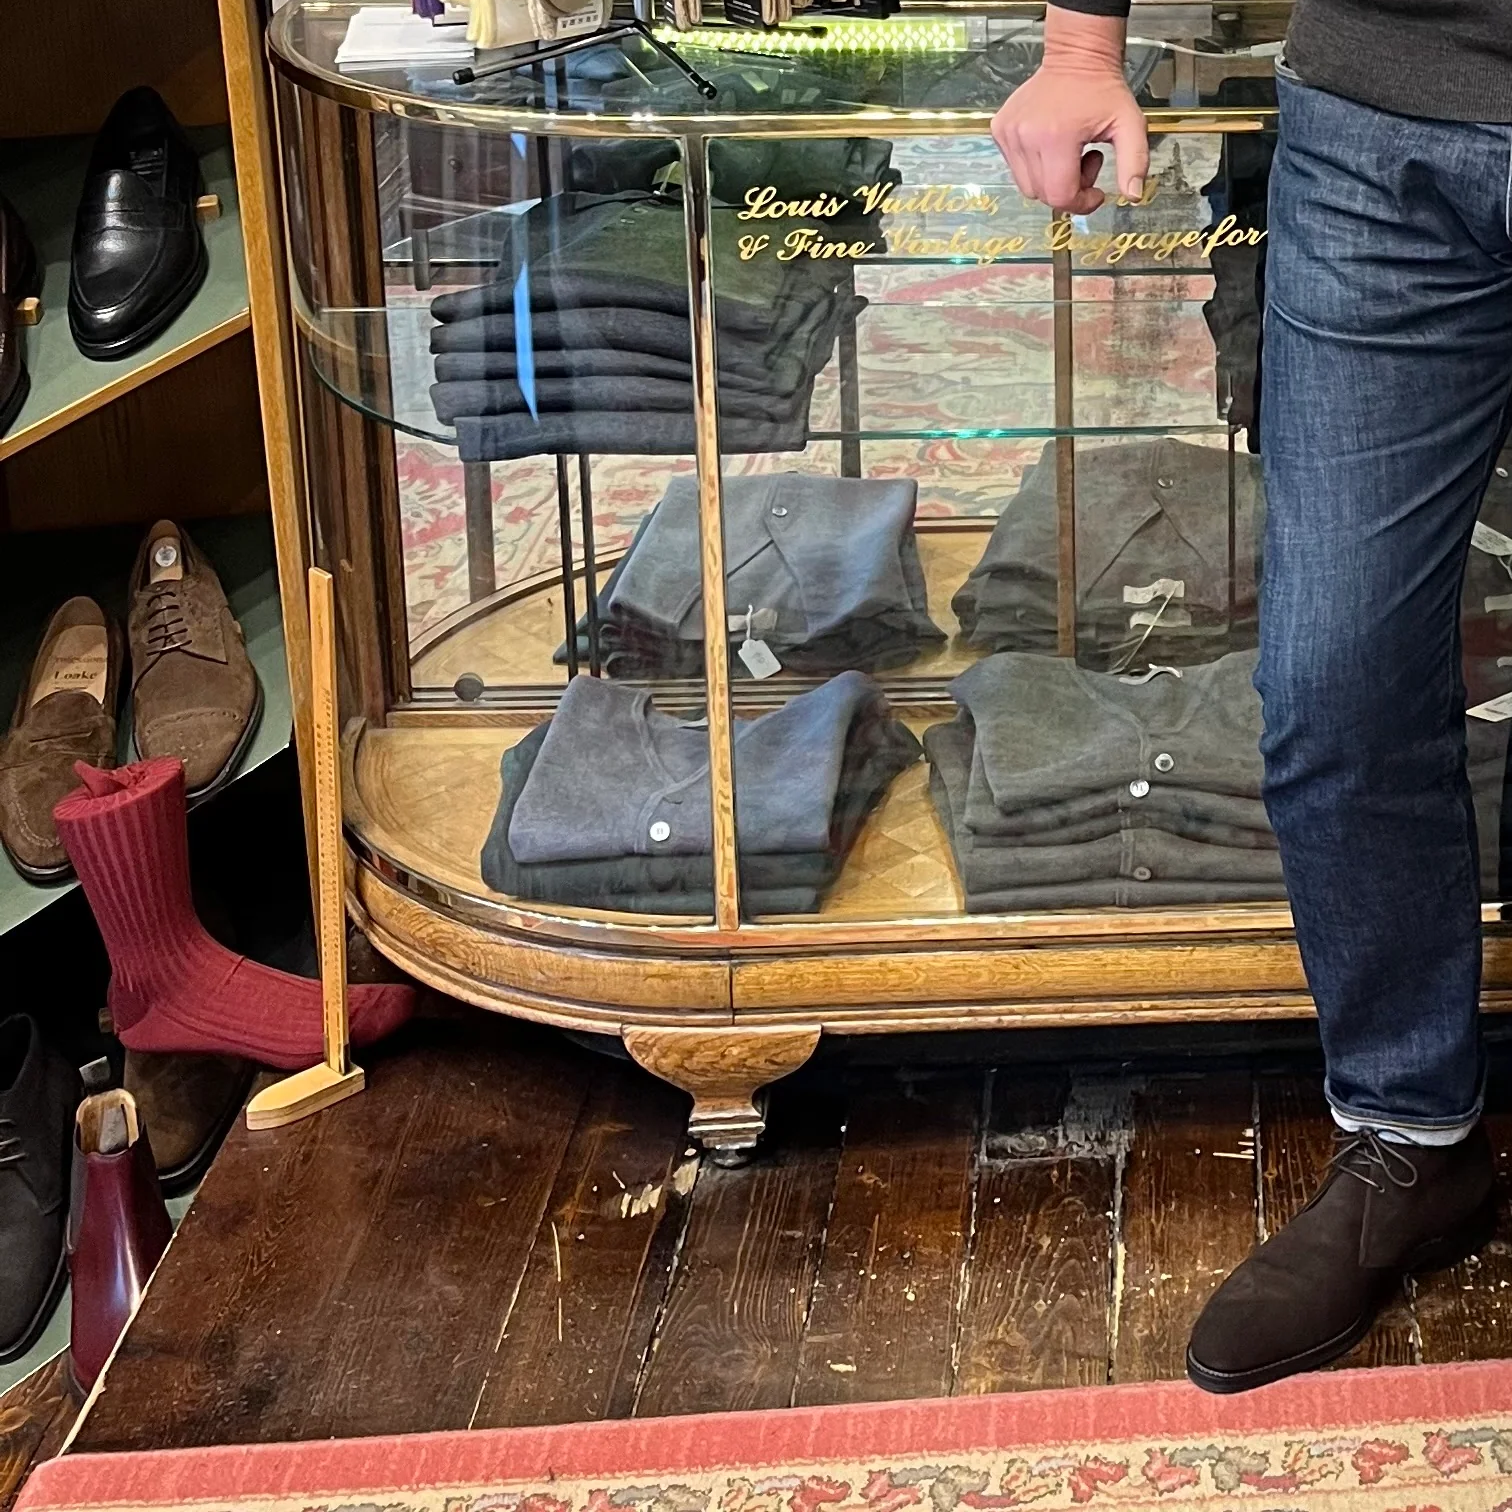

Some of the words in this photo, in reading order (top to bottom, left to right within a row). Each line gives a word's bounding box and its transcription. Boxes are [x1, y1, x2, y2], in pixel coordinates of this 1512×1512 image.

[737, 185, 849, 221] Louis
[853, 181, 999, 216] Vuitton,
[737, 234, 770, 260] &
[776, 228, 876, 261] Fine
[881, 225, 1030, 266] Vintage
[1042, 220, 1204, 265] Luggage
[1199, 214, 1269, 258] for
